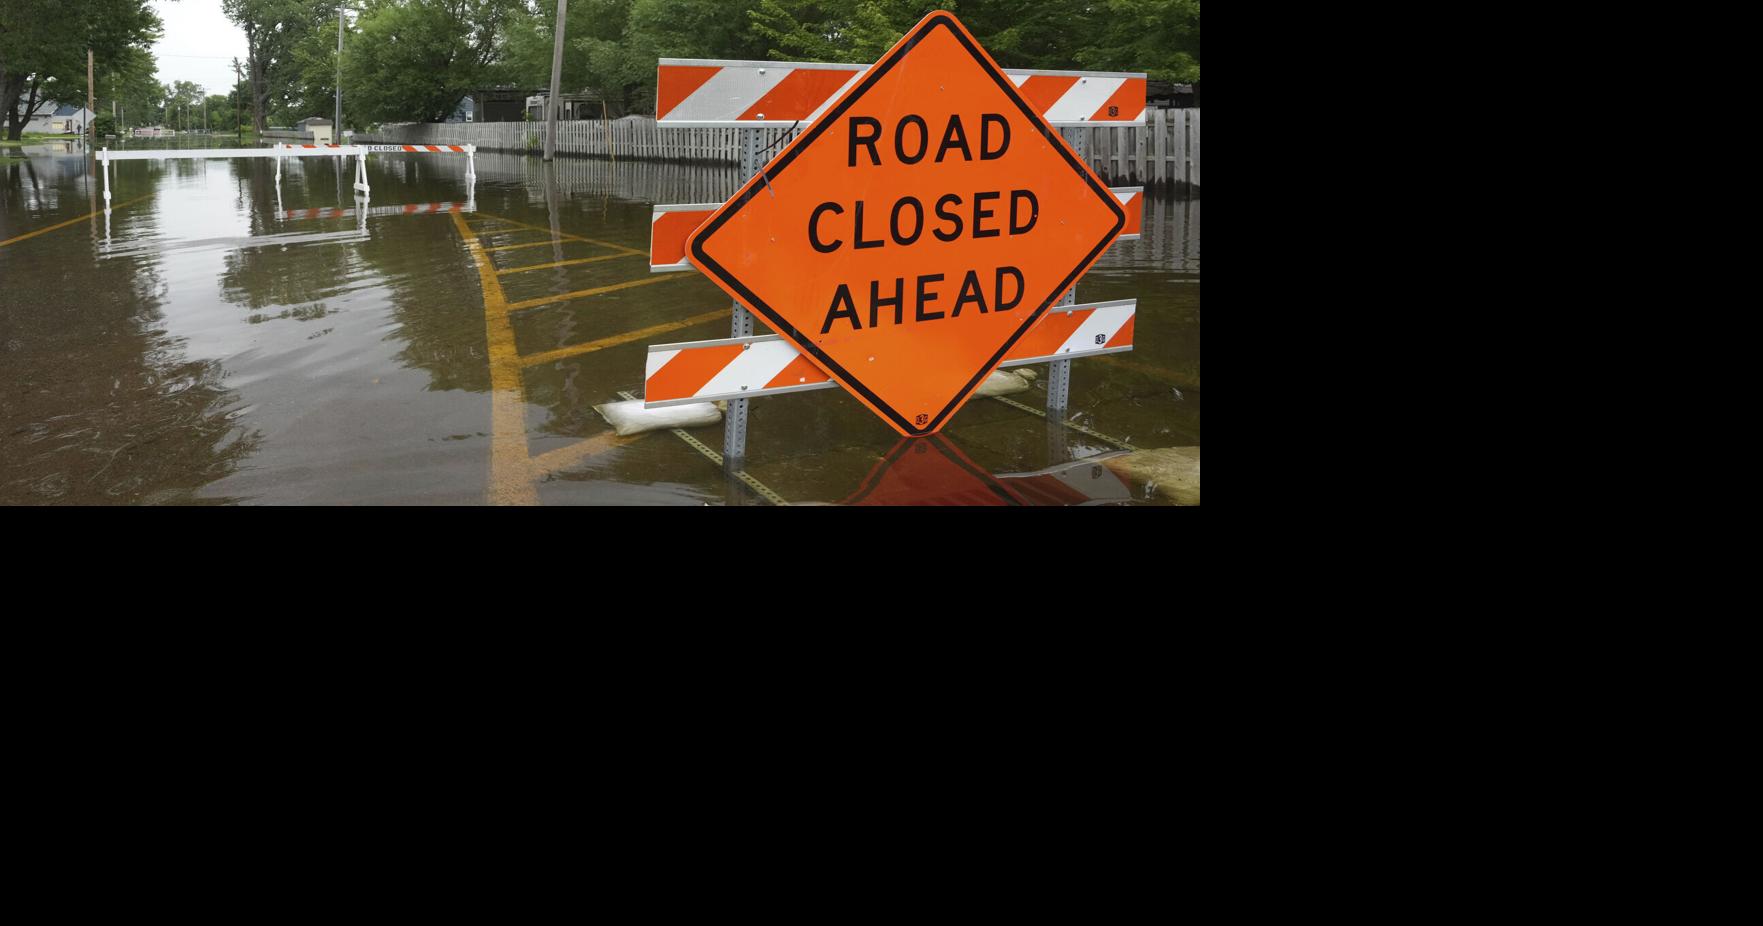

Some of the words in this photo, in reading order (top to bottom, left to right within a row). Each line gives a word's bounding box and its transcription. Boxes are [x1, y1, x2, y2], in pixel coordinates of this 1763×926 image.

[847, 113, 1011, 168] ROAD
[808, 189, 1040, 254] CLOSED
[820, 265, 1025, 335] AHEAD
